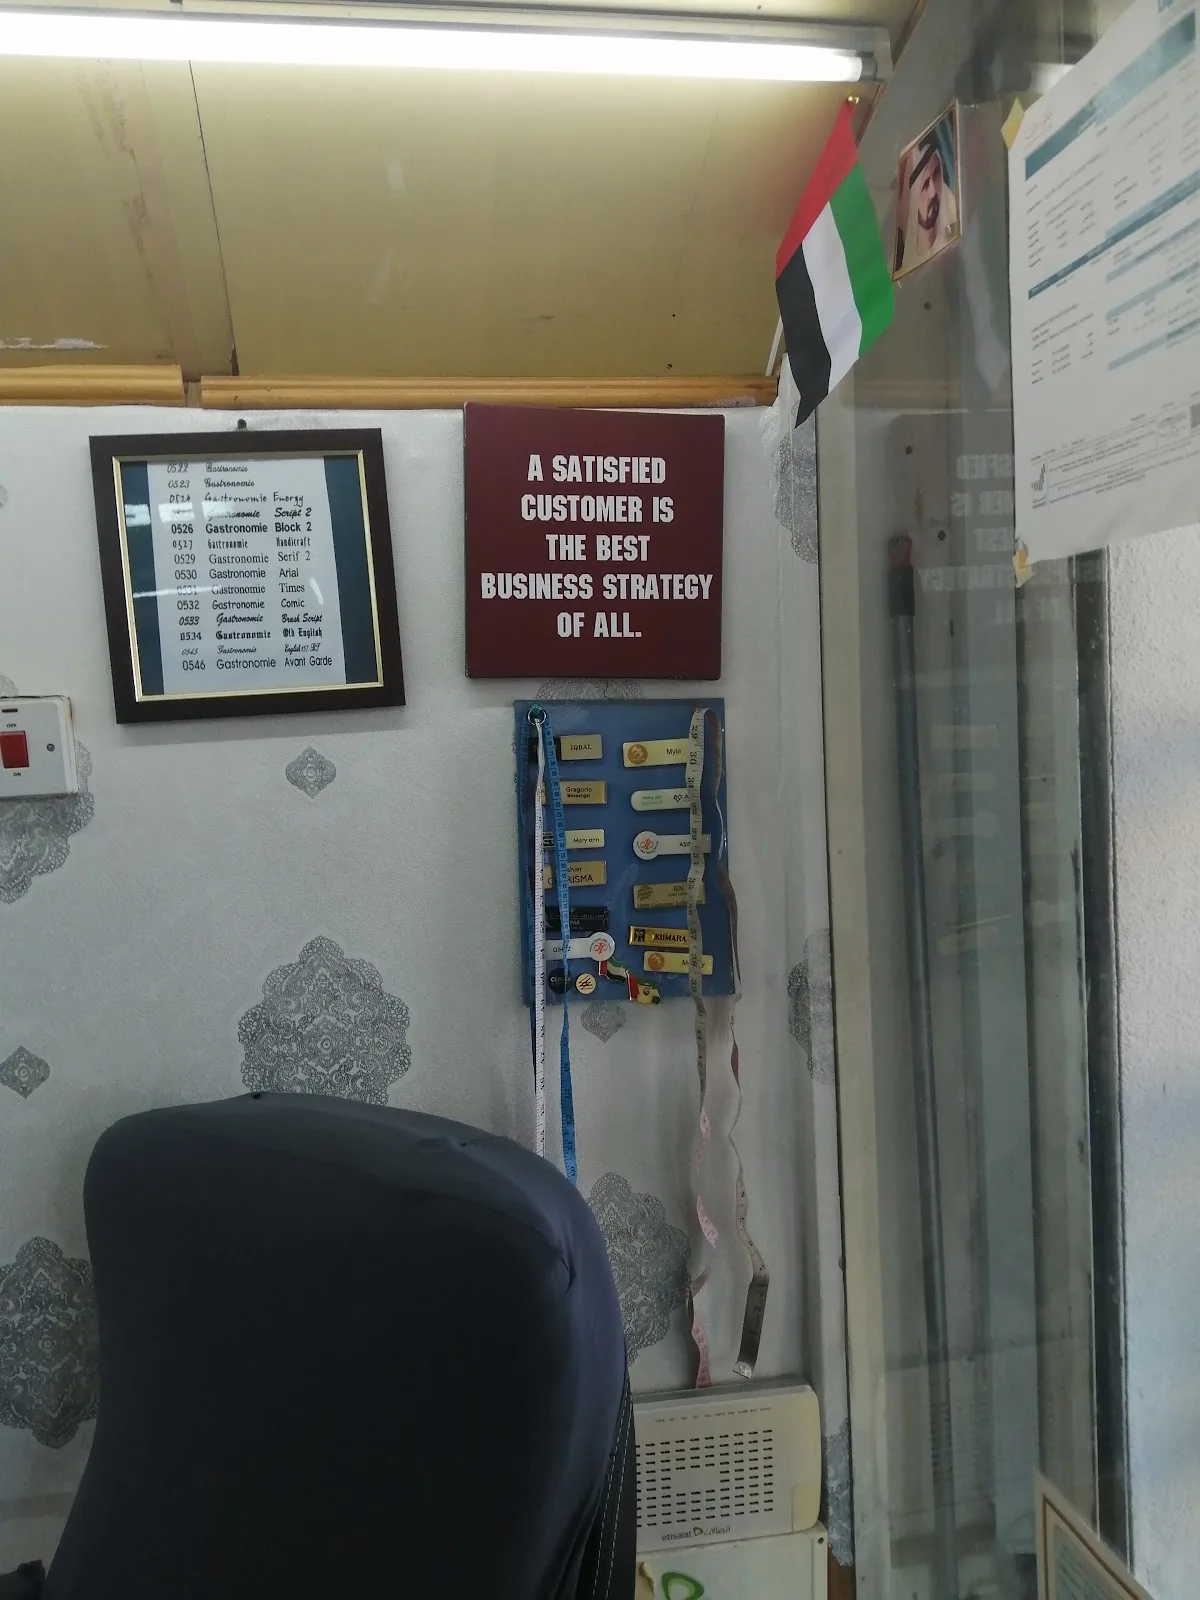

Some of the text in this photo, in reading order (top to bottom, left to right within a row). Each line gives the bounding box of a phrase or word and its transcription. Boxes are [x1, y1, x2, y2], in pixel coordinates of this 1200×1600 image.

[527, 454, 666, 484] A SATISFIED
[168, 477, 255, 489] 0523 Gastronomie
[273, 491, 304, 507] Energy
[274, 507, 302, 520] Script
[305, 507, 313, 517] 2
[521, 493, 674, 523] CUSTOMER IS
[171, 522, 313, 534] 0526 Gastronomie Block 2
[172, 536, 311, 550] 0527 Gastronomie Handicraft
[545, 533, 651, 562] THE BEST
[174, 550, 311, 565] 0529 Gastronomie Serif 2
[174, 567, 299, 580] 0530 Gastronomie Arial
[176, 583, 305, 596] 0531 Gastronomie Times
[481, 572, 714, 600] BUSINESS STRATEGY
[177, 598, 305, 611] 0532 Gastronomie Comic
[179, 612, 323, 628] 0533 Gastronomie Brush Script
[557, 611, 642, 638] OF ALL.
[180, 627, 323, 641] 0534 Gastronomie Old English
[182, 655, 333, 671] 0546 Gastronomie Avant Garde
[570, 743, 592, 751] IQBAL
[565, 786, 593, 794] Gregorio
[661, 1530, 693, 1542] etisalat
